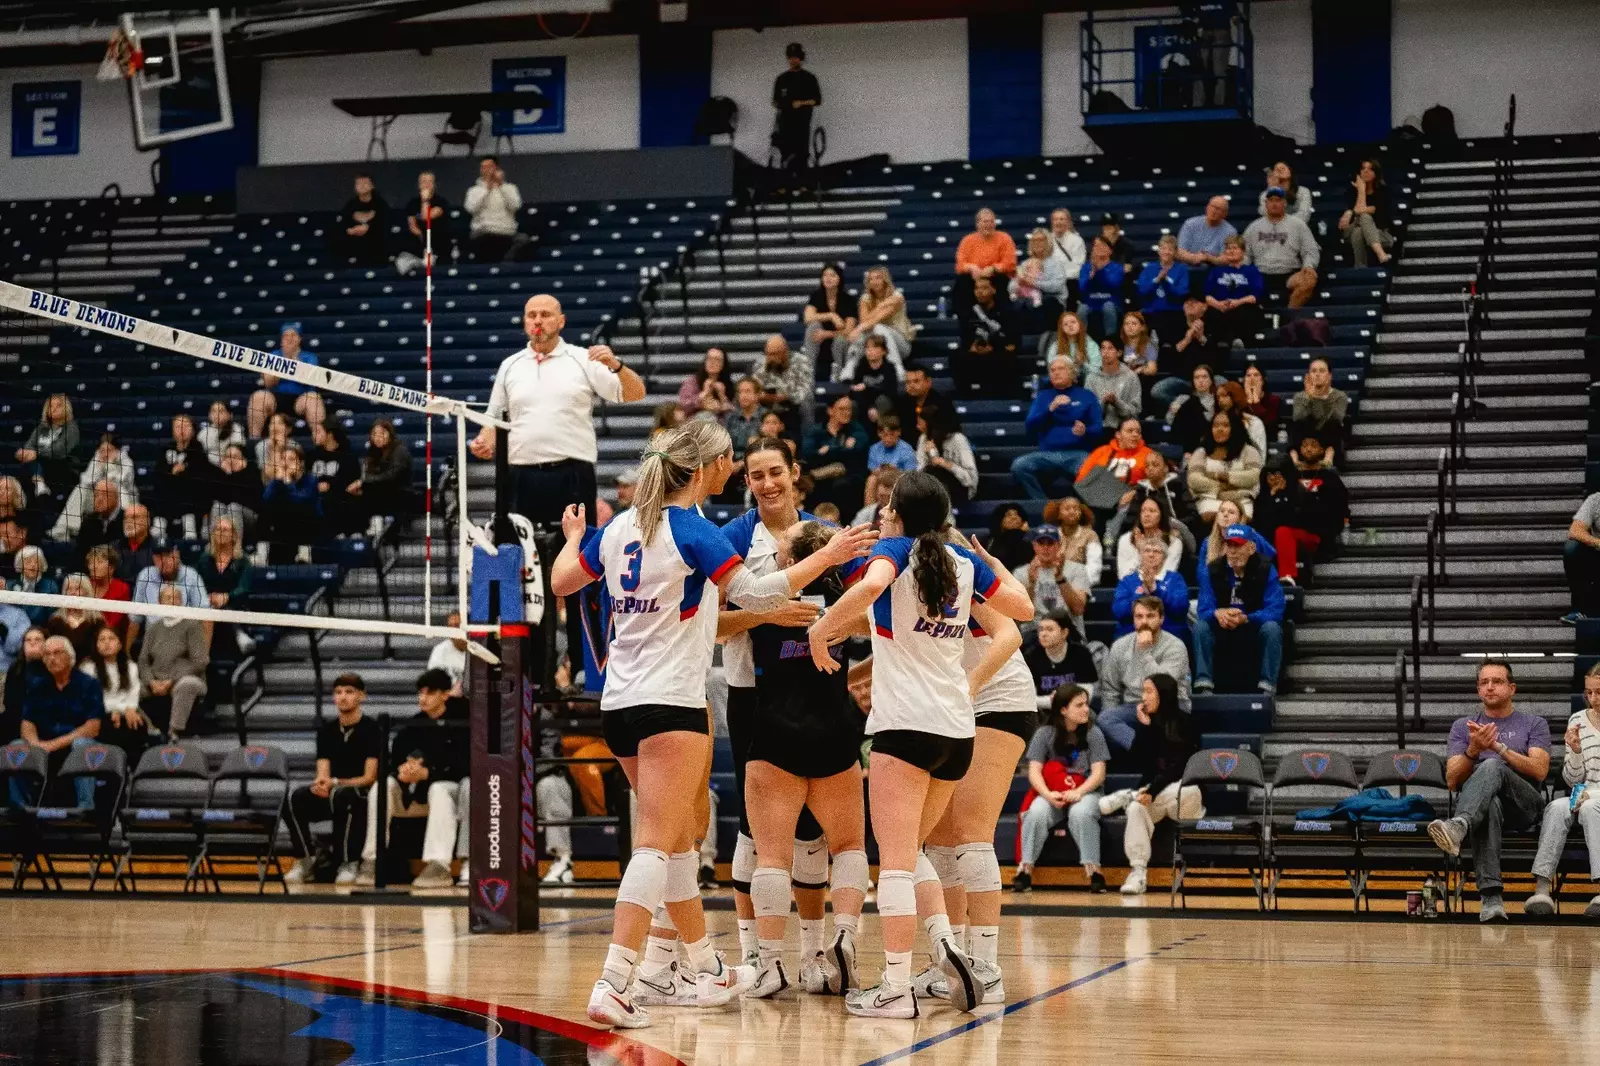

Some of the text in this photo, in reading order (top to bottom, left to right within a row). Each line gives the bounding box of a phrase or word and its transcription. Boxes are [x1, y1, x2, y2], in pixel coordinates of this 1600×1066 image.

[512, 83, 543, 125] D
[32, 107, 58, 147] E
[29, 291, 137, 333] BLUE DEMONS
[212, 341, 298, 376] BLUE DEMONS
[358, 379, 428, 408] BLUE DEMONS
[619, 540, 643, 592] 3
[488, 775, 502, 816] sports
[488, 818, 502, 869] imports
